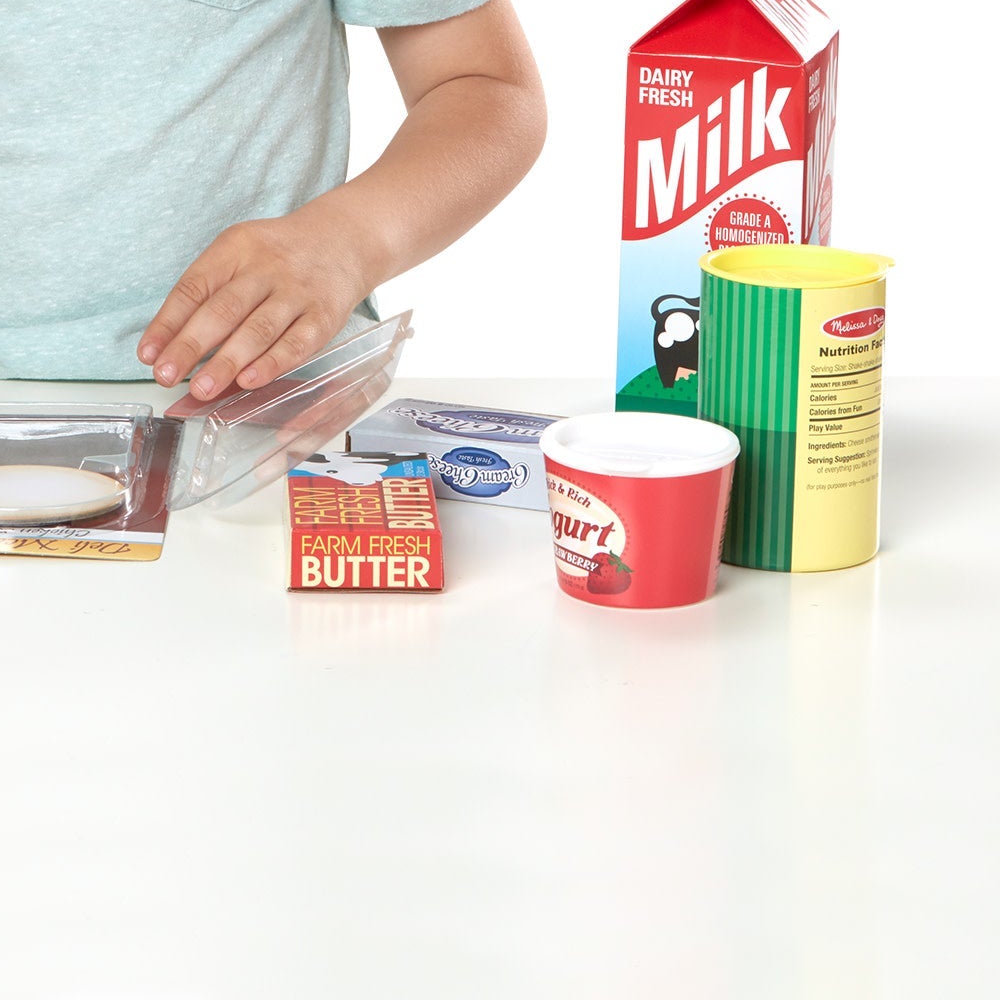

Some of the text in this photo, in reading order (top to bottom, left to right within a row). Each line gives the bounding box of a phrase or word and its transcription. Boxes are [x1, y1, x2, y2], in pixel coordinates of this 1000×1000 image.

[639, 66, 694, 87] DAIRY
[638, 87, 693, 107] FRESH
[635, 66, 792, 229] Milk
[730, 211, 771, 228] GRADE A
[715, 227, 784, 244] HOMOGENIZED
[831, 320, 867, 335] Melissa
[819, 344, 869, 357] Nutrition
[809, 394, 837, 402] Calories
[809, 408, 836, 416] Calories
[809, 423, 843, 433] Play Value
[808, 441, 846, 451] Ingredients:
[458, 454, 494, 465] Fresh Taste
[807, 457, 834, 466] Serving
[834, 451, 866, 463] Suggestion:
[428, 454, 530, 488] Cream Cheese
[381, 478, 435, 530] BUTTER
[558, 483, 565, 494] &
[567, 487, 591, 508] Rich
[293, 487, 339, 525] FARM
[338, 487, 384, 525] FRESH
[20, 527, 90, 537] Chicken
[550, 507, 616, 547] gurt
[71, 541, 131, 554] Deli
[302, 536, 430, 555] FARM FRESH
[302, 555, 430, 587] BUTTER
